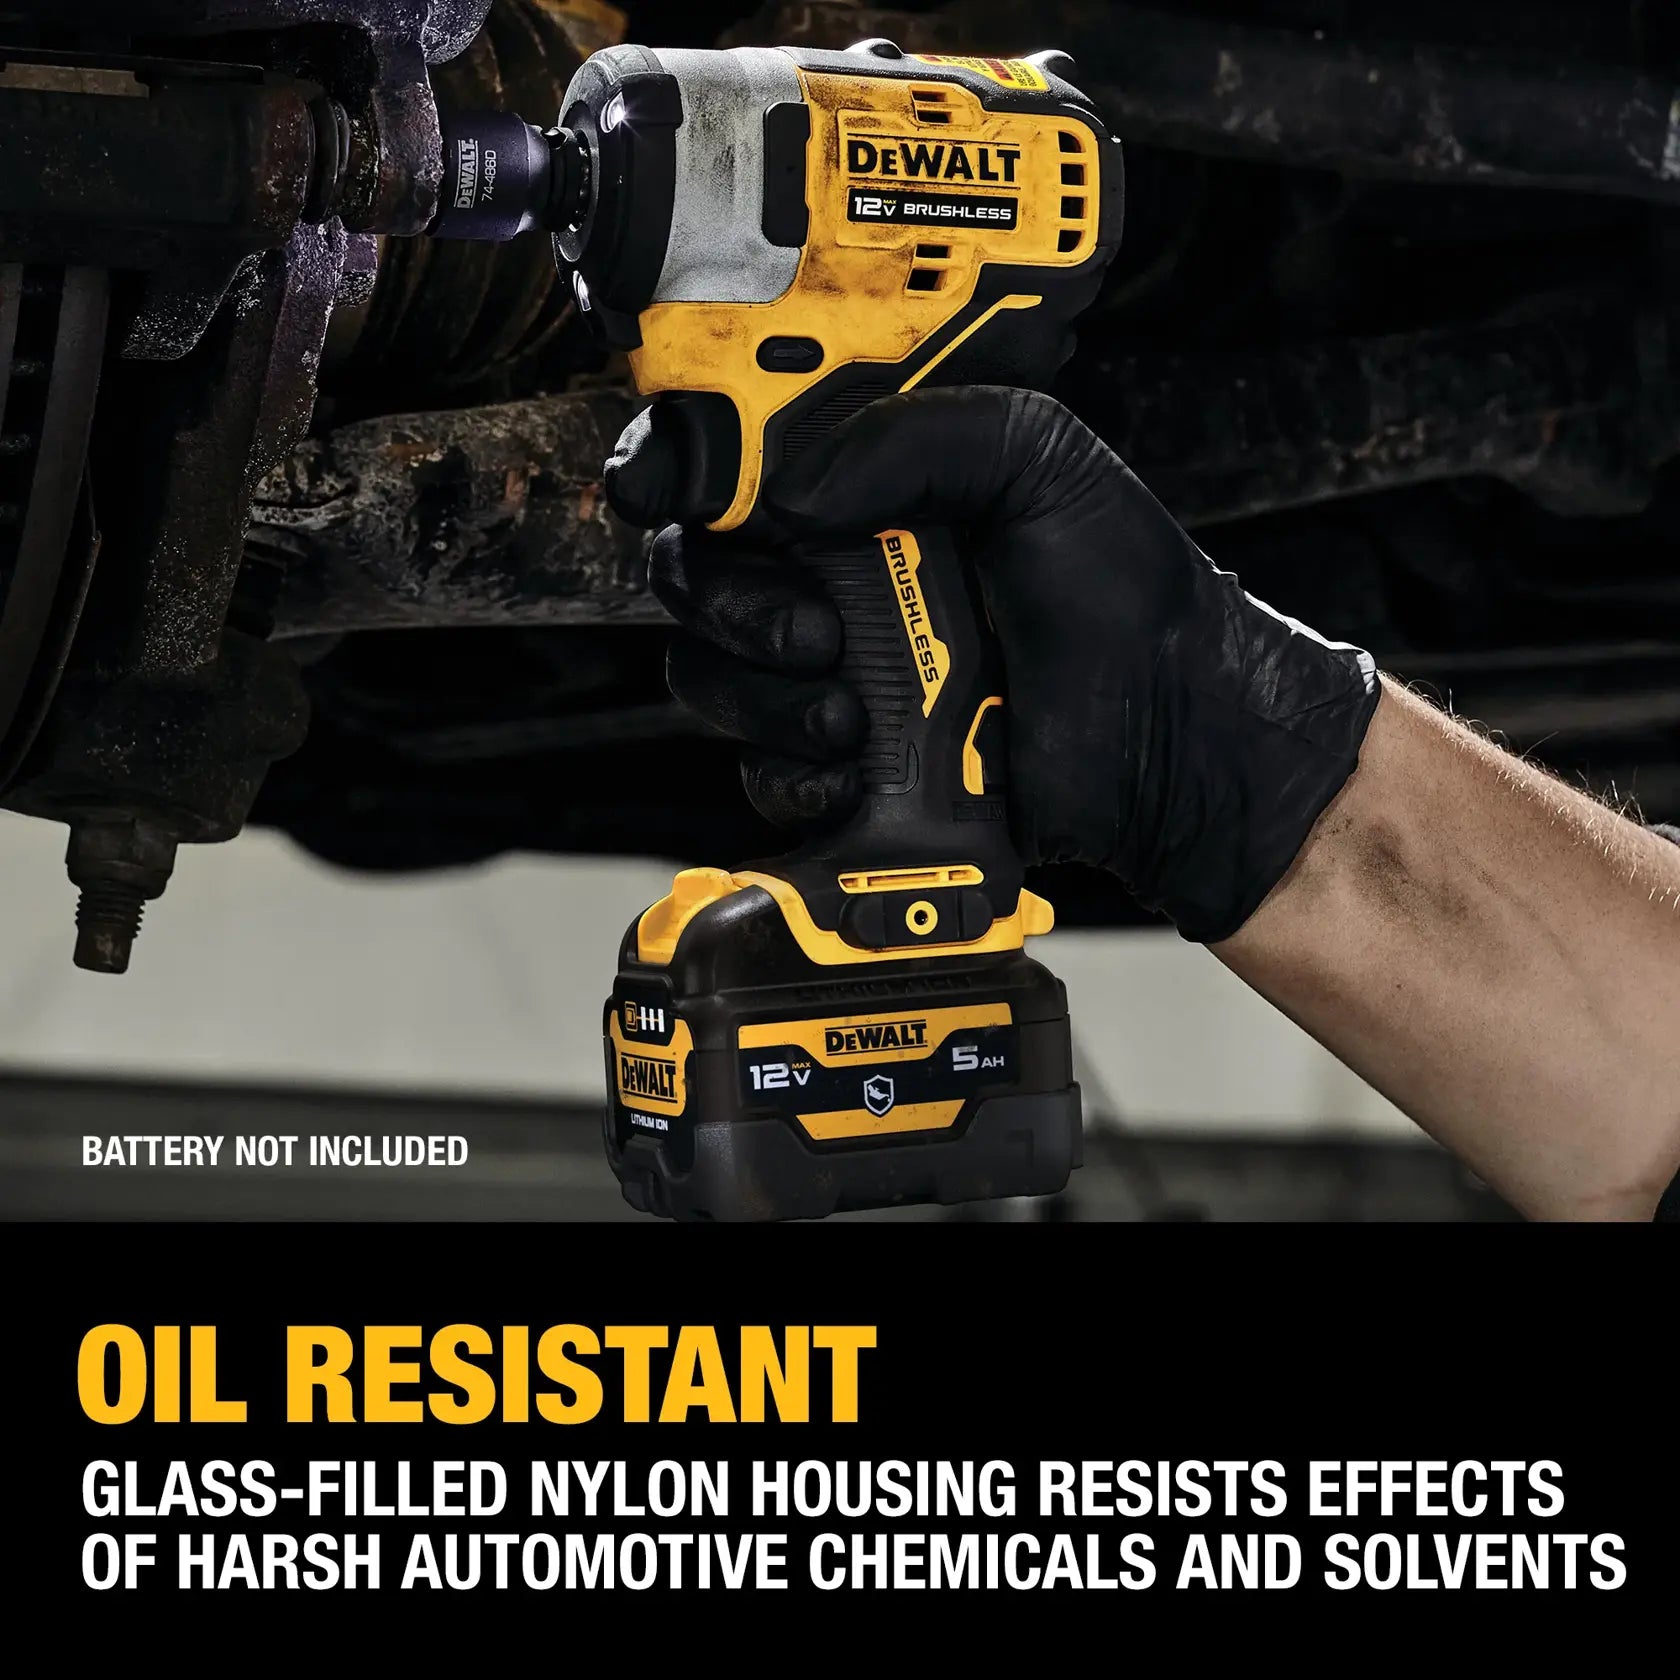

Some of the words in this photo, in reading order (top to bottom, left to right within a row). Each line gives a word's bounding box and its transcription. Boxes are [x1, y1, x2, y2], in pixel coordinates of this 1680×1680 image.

[847, 139, 1021, 182] DEWALT
[903, 202, 1012, 220] BRUSHLESS
[885, 535, 940, 683] BRUSHLESS
[825, 1022, 928, 1053] DEWALT
[621, 1056, 676, 1099] DEWALT
[791, 1061, 811, 1069] MAX
[655, 1118, 669, 1131] ION
